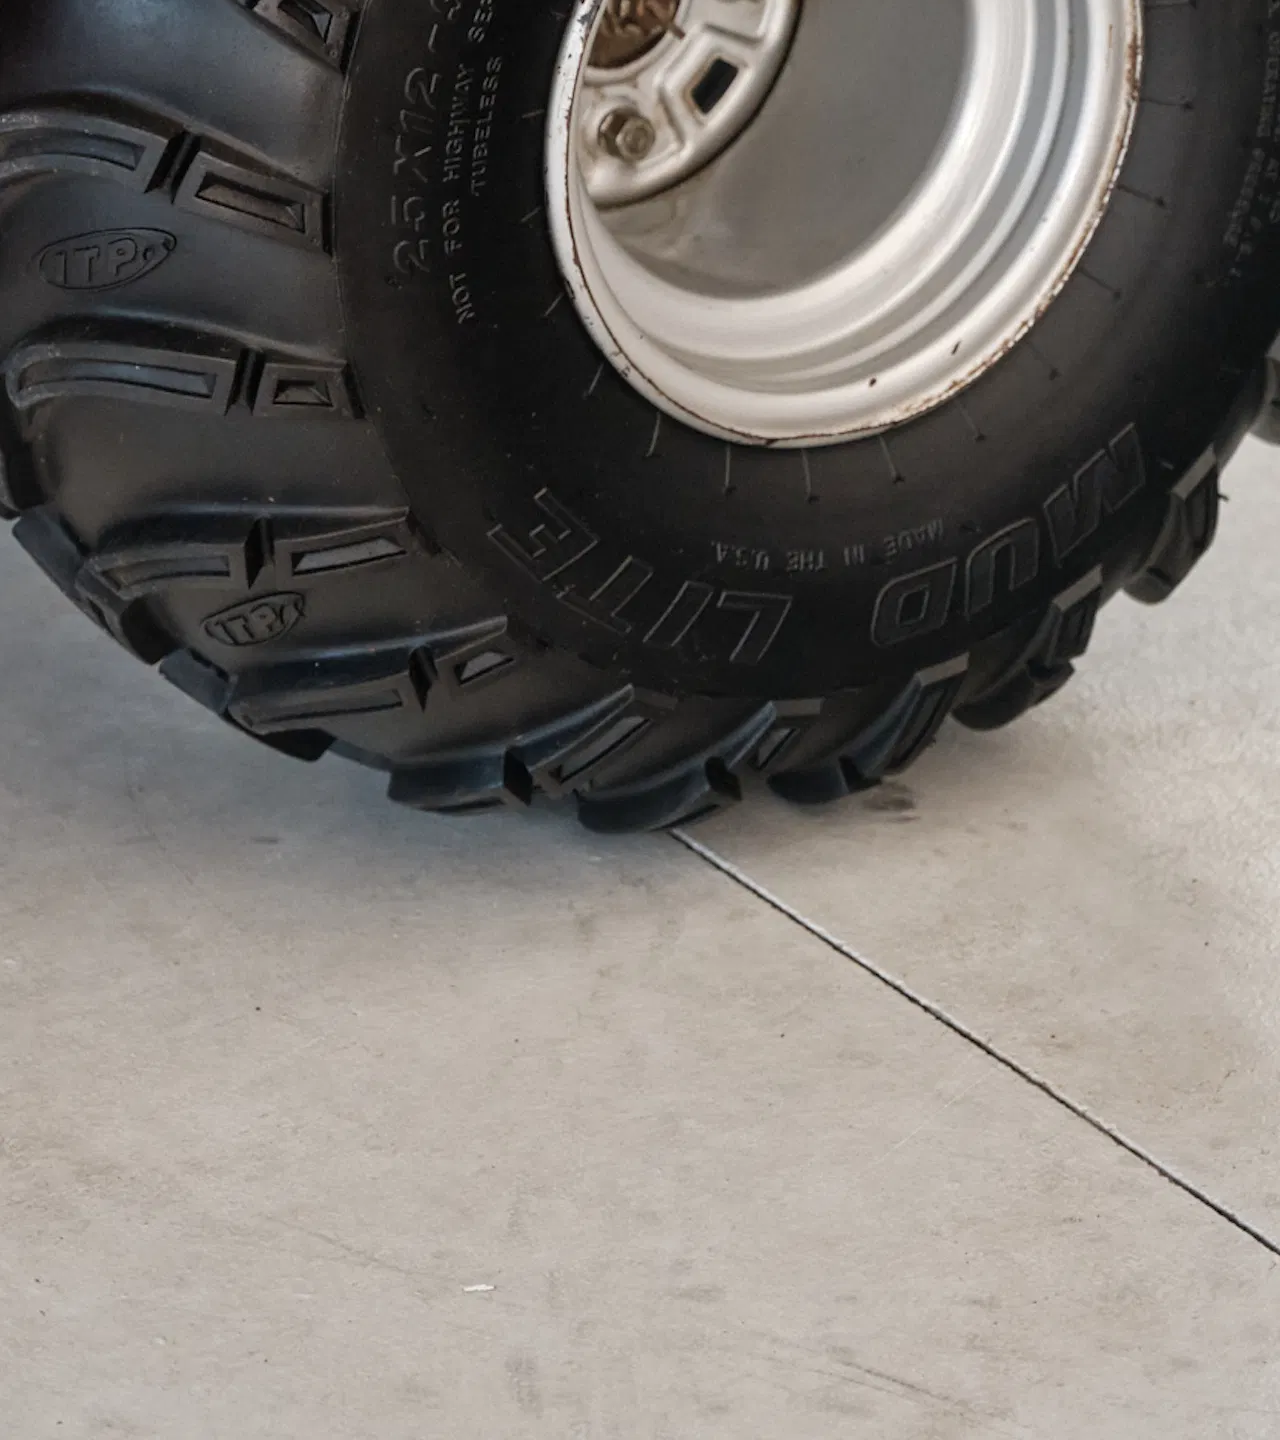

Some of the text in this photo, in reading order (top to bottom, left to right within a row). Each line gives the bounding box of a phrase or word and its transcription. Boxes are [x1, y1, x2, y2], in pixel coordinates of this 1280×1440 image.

[442, 62, 474, 182] HIGHWAY
[471, 56, 502, 197] TUBELESS
[442, 199, 463, 255] FOR
[449, 272, 476, 324] NOT
[484, 421, 1148, 665] MUD LITE
[786, 548, 827, 573] THE
[842, 543, 865, 566] IN
[883, 517, 944, 564] MADE
